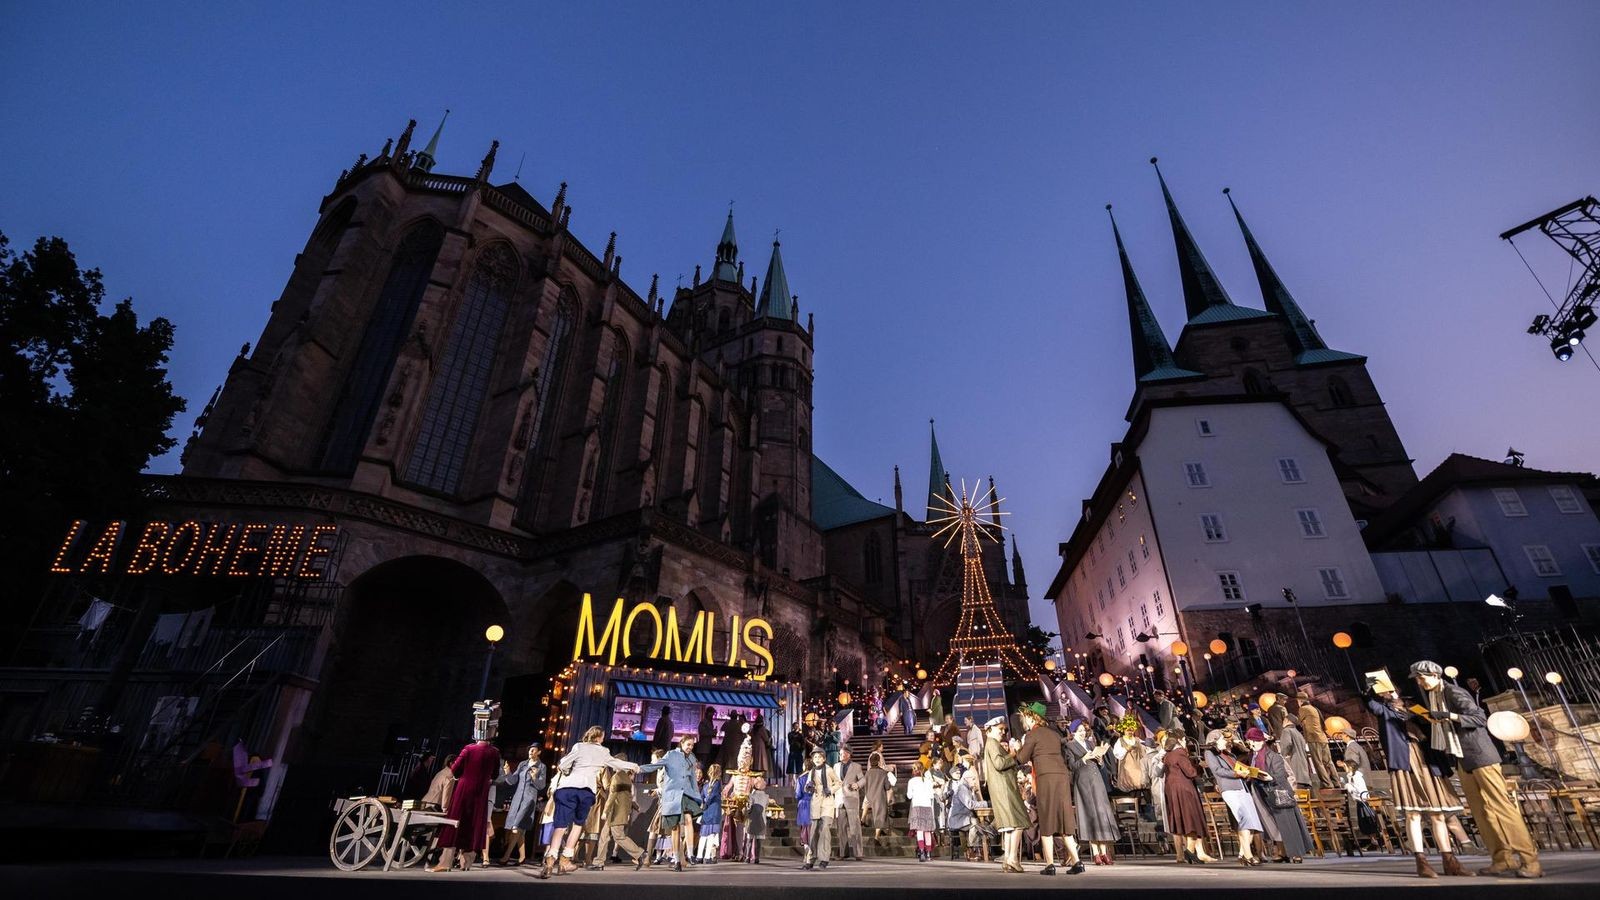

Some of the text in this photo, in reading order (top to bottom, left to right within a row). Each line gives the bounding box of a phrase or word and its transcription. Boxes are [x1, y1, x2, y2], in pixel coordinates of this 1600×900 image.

[50, 519, 337, 577] LA BOHEME
[573, 592, 774, 682] MOMUS
